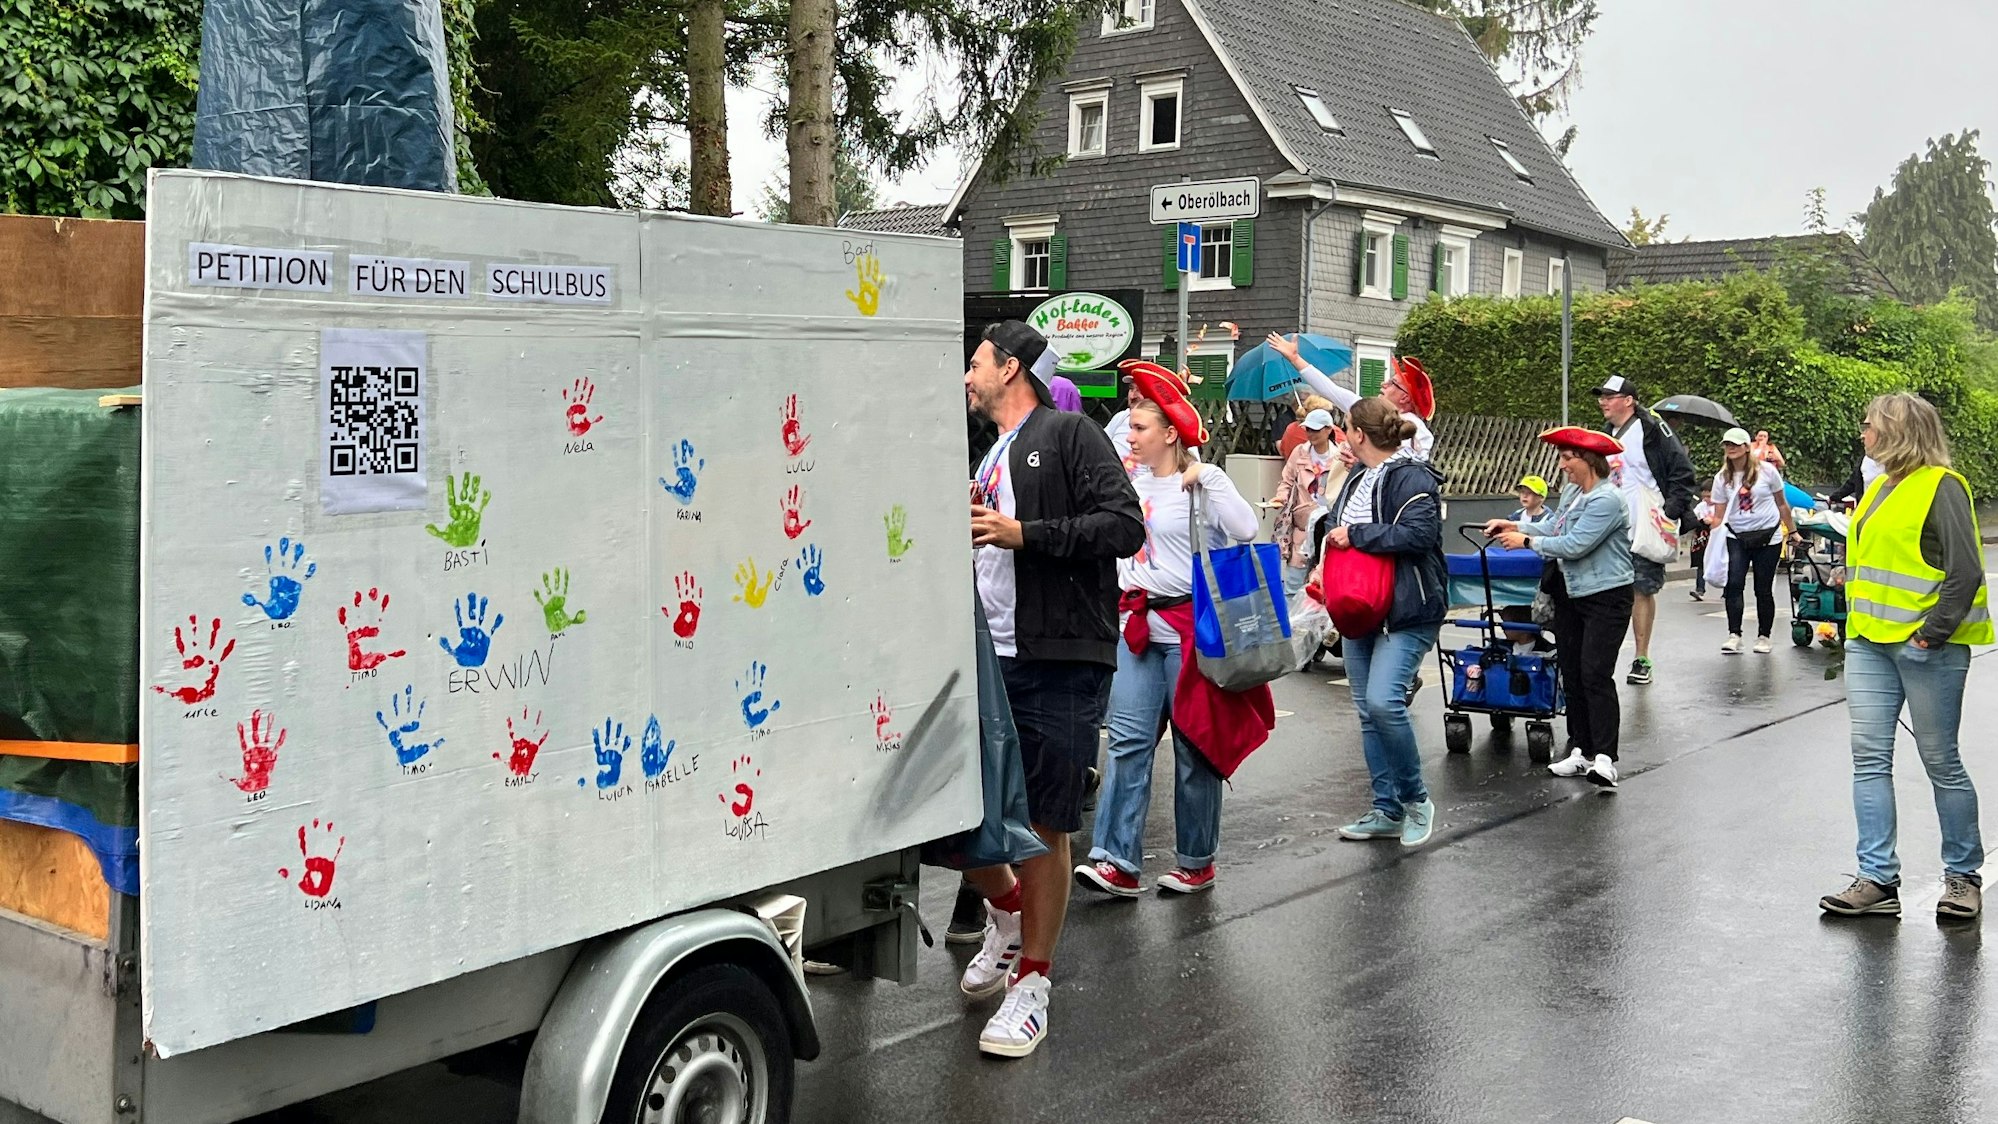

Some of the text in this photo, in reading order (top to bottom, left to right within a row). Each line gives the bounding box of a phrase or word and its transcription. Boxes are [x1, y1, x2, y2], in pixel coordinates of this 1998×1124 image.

[1178, 189, 1250, 210] Oberölbach
[198, 251, 606, 297] PETITION FÜR DEN SCHULBUS
[1035, 298, 1120, 330] Hof-Laden
[1057, 318, 1099, 332] Bakker
[563, 438, 595, 456] Nela
[786, 459, 815, 474] LULU
[774, 557, 789, 592] Clara
[674, 639, 694, 650] MILO
[448, 642, 555, 694] ERWIN
[504, 772, 540, 788] EMILY
[247, 790, 266, 803] LEO
